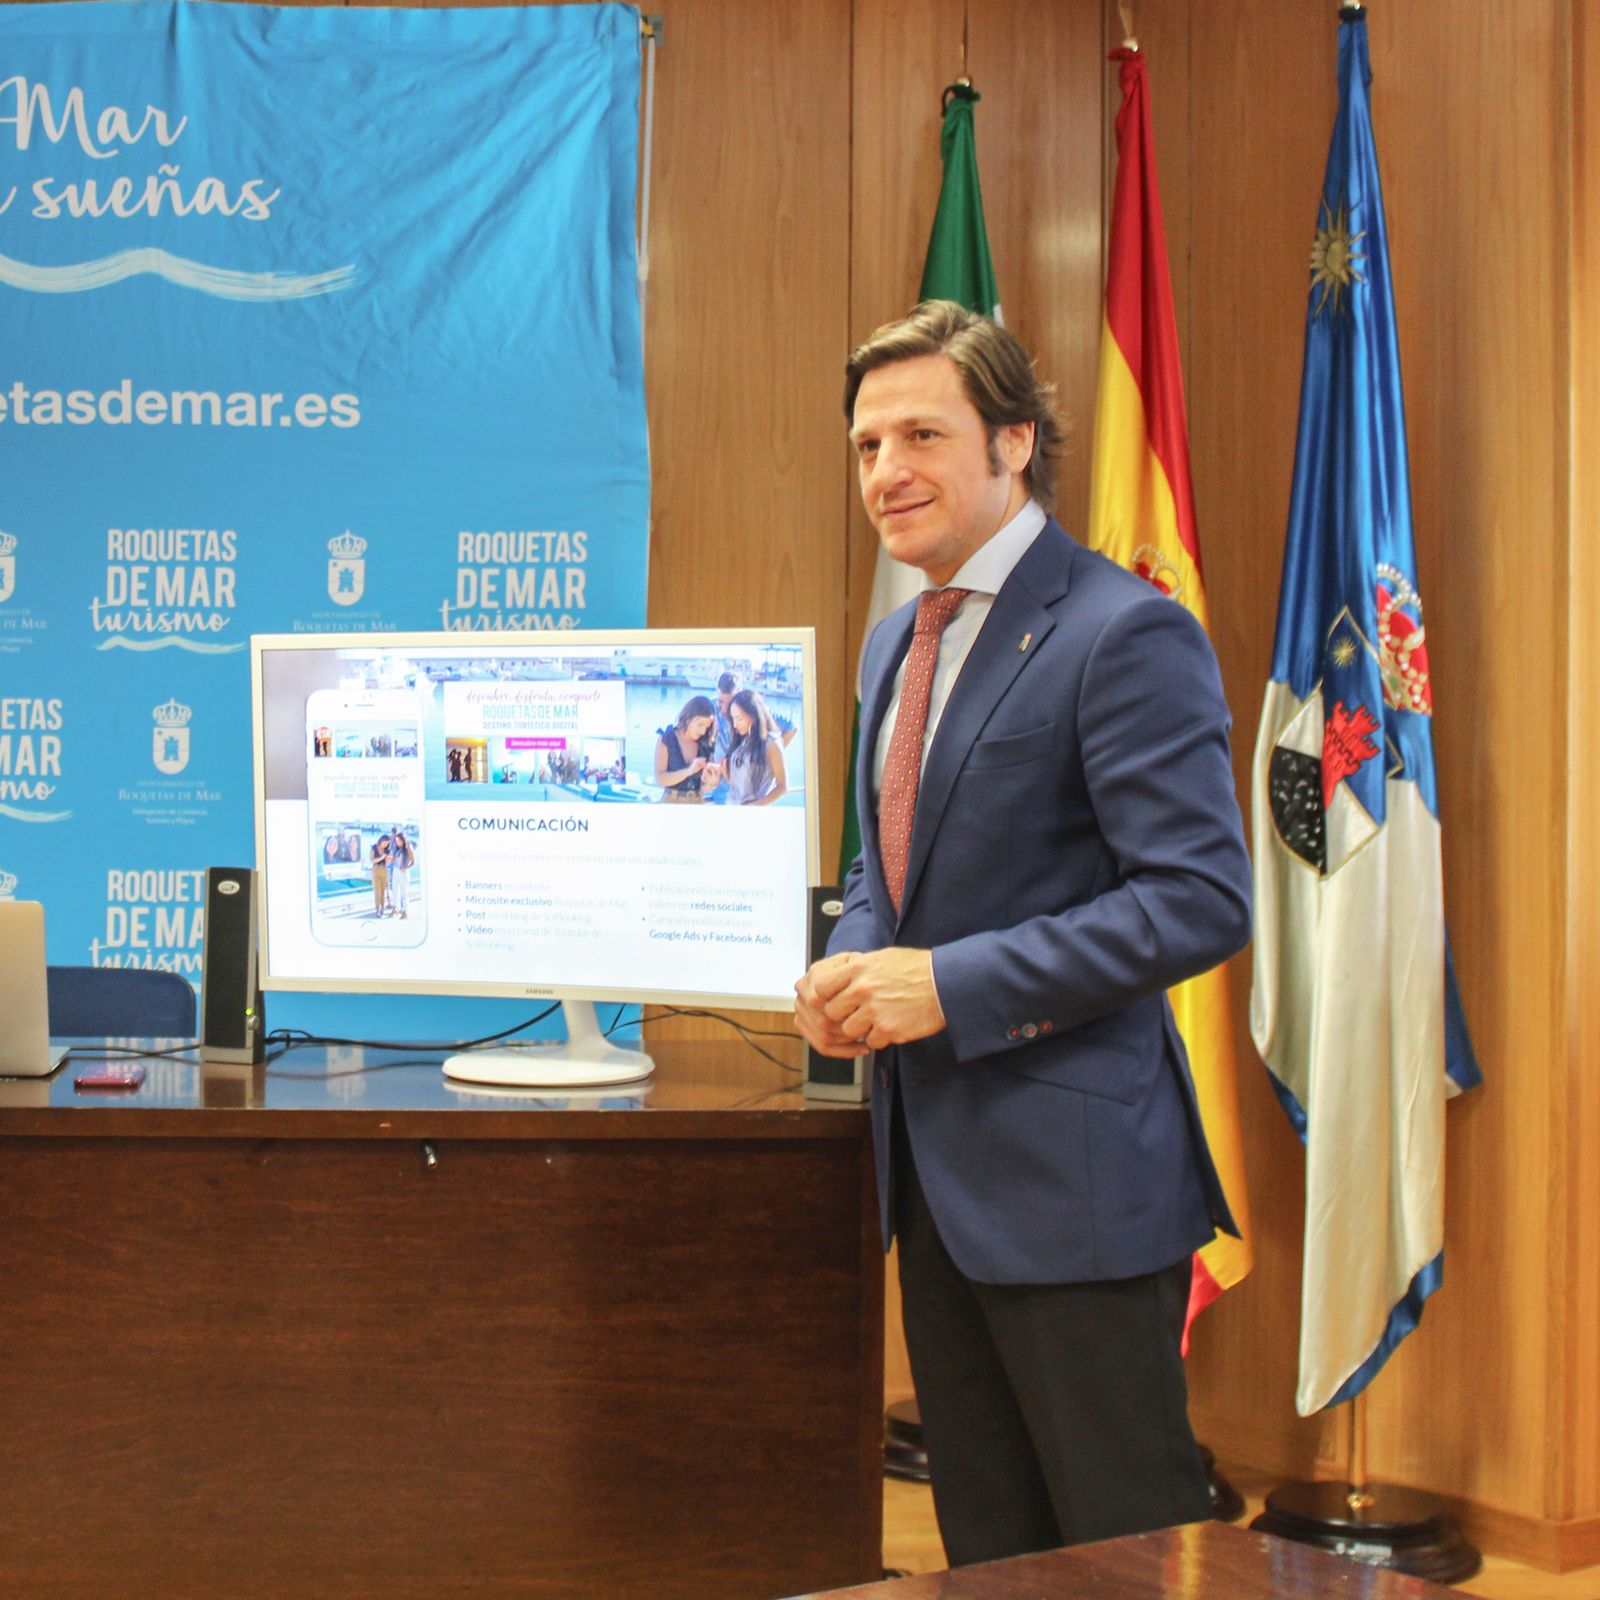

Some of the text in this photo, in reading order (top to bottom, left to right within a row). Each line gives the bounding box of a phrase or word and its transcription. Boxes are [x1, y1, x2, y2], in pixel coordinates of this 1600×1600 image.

[32, 163, 281, 220] sueñas
[0, 379, 361, 428] tasdemar.es
[107, 529, 237, 562] ROQUETAS
[457, 531, 588, 564] ROQUETAS
[106, 566, 236, 608] DE MAR
[456, 567, 586, 609] DE MAR
[88, 597, 230, 632] turismo
[438, 598, 581, 631] turismo
[458, 815, 589, 832] COMUNICACIÓN
[107, 870, 205, 902] ROQUET
[465, 880, 503, 890] Banners
[465, 896, 509, 905] Microsite
[511, 896, 553, 906] exclusivo
[465, 910, 486, 919] Post
[691, 901, 716, 911] redes
[717, 902, 753, 912] sociales
[106, 907, 204, 948] DE MA
[649, 928, 773, 944] Google Ads y Facebook Ads
[88, 937, 202, 973] turism
